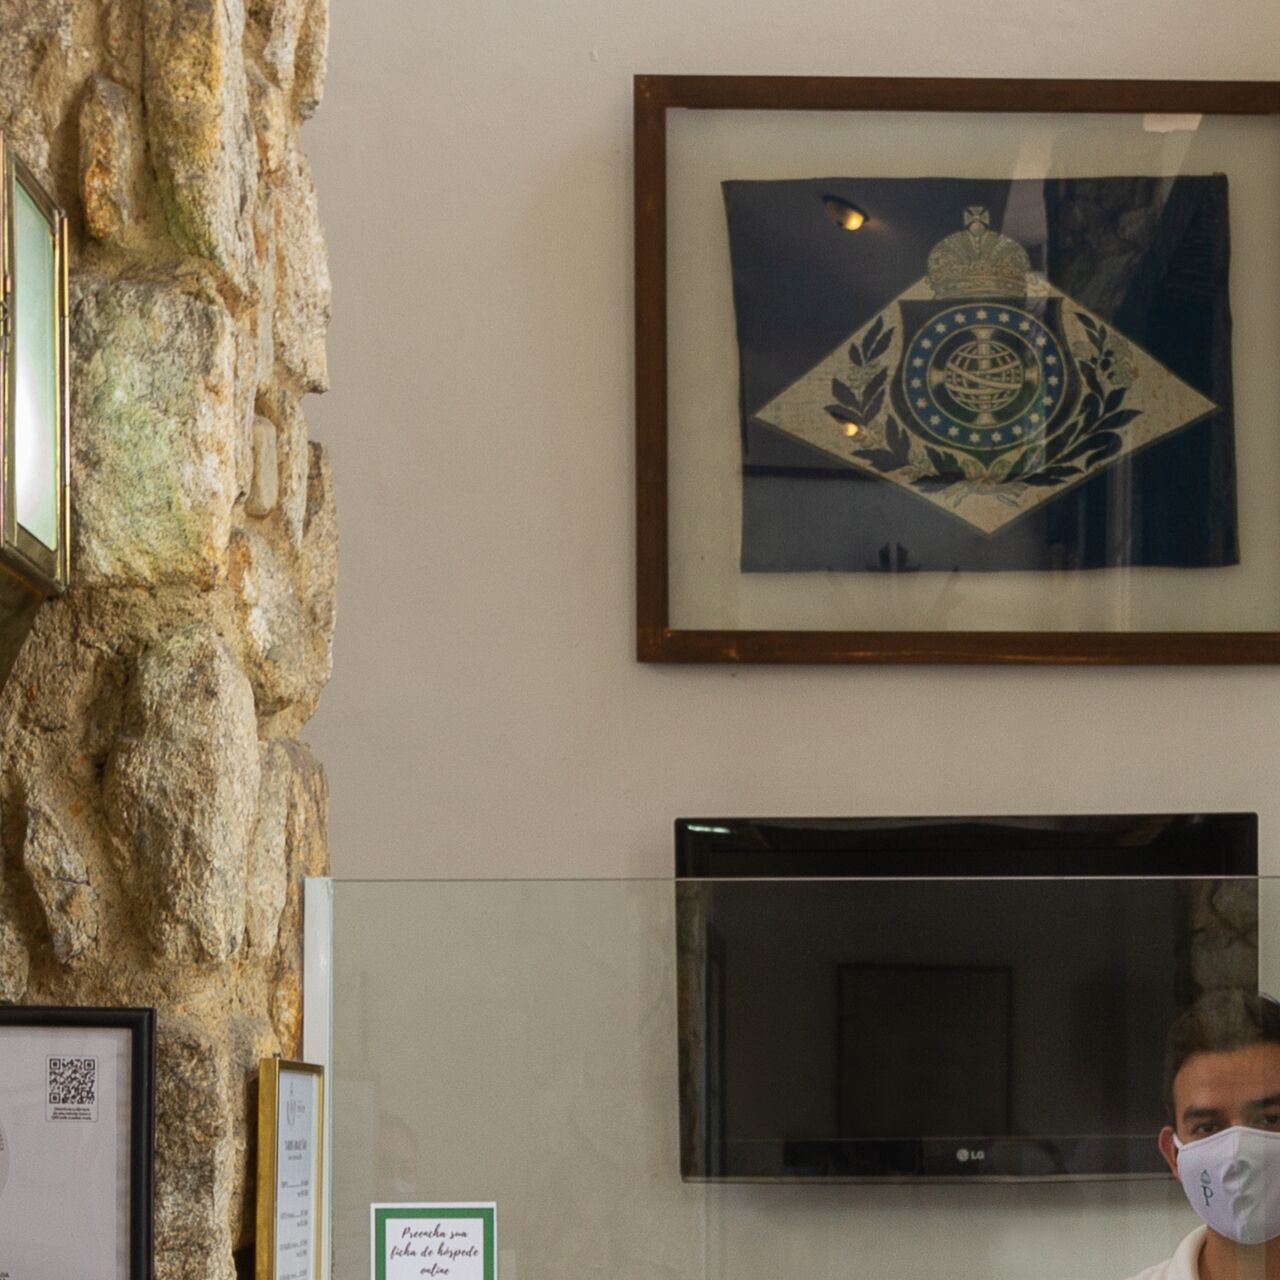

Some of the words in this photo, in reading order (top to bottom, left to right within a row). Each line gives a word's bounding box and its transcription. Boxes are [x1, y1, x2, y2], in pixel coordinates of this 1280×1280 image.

[971, 1151, 984, 1159] LG
[401, 1223, 446, 1239] Preencha
[390, 1242, 416, 1260] ficha
[420, 1246, 433, 1257] de
[437, 1242, 478, 1261] hóspede
[420, 1263, 449, 1277] online
